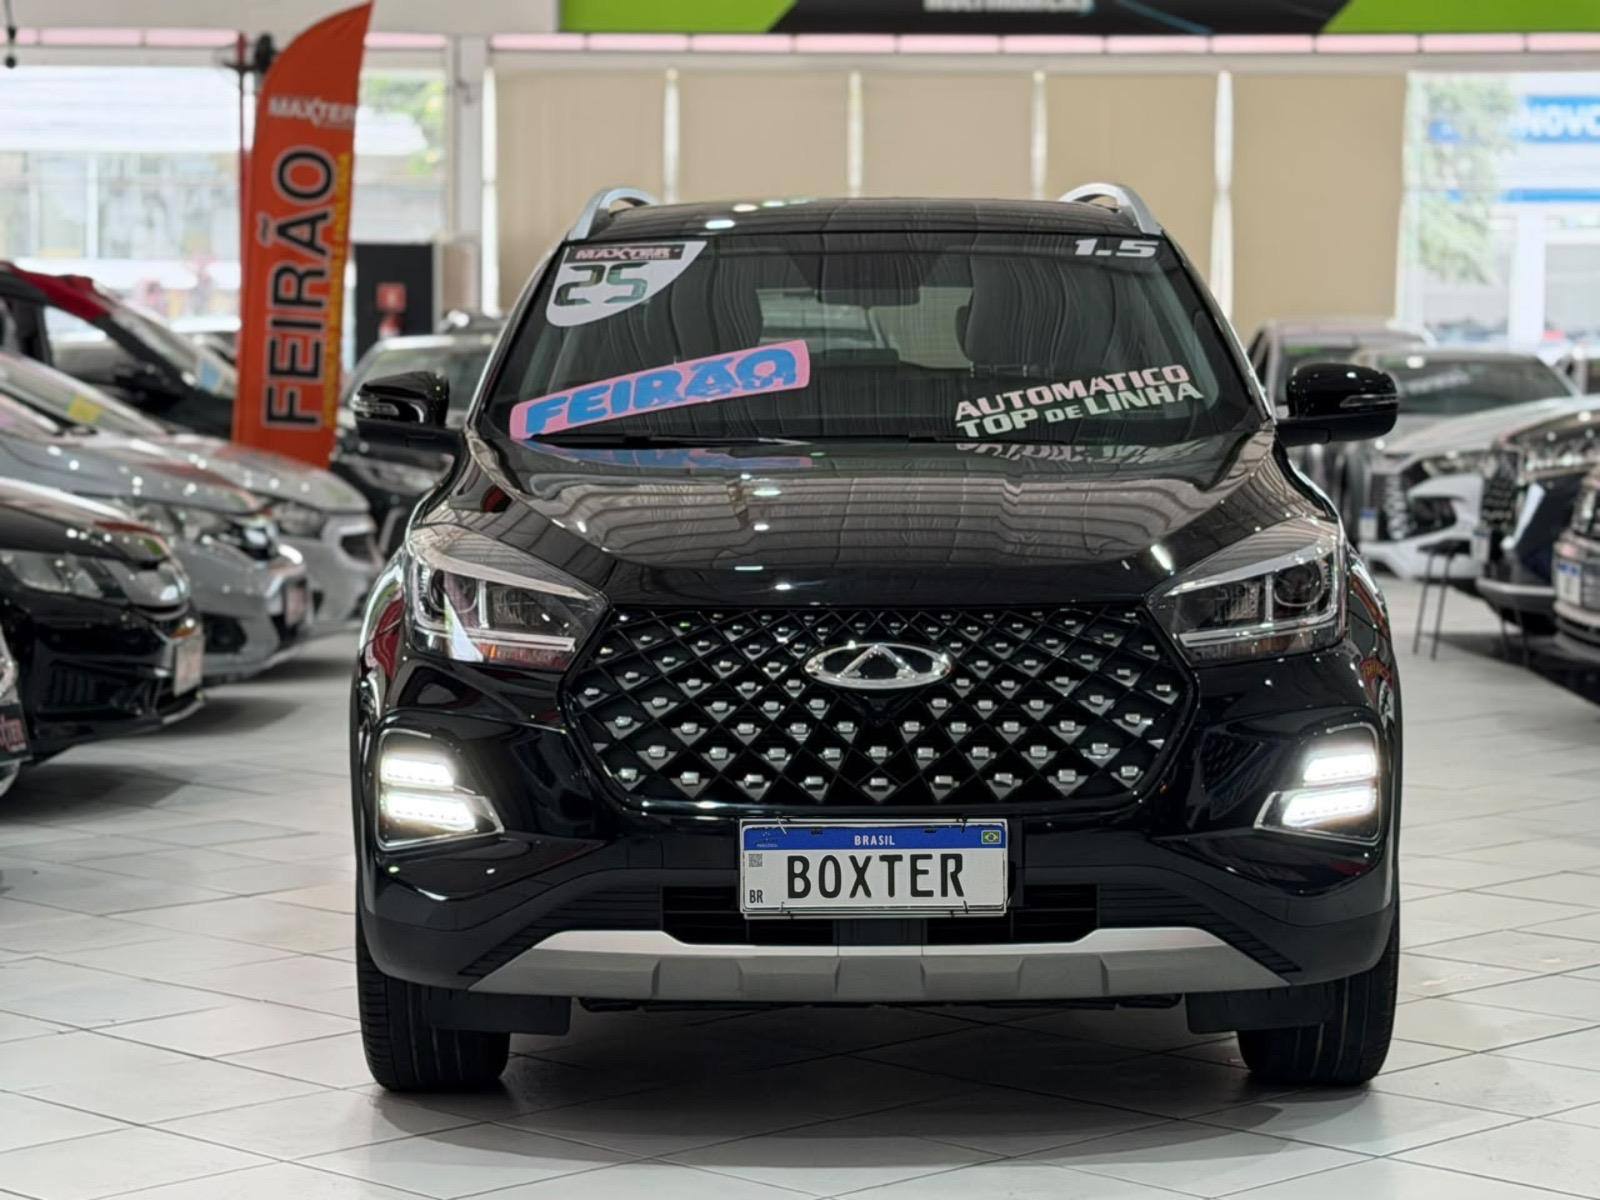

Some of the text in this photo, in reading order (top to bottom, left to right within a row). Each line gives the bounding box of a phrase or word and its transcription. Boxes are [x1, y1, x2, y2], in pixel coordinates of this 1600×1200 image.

[1075, 238, 1159, 257] 1.5
[258, 146, 335, 429] FEIRÃO
[553, 262, 649, 307] 25
[957, 382, 1204, 438] TOP DE LINHA
[854, 835, 895, 846] BRASIL
[749, 889, 763, 904] BR
[787, 853, 964, 899] BOXTER
